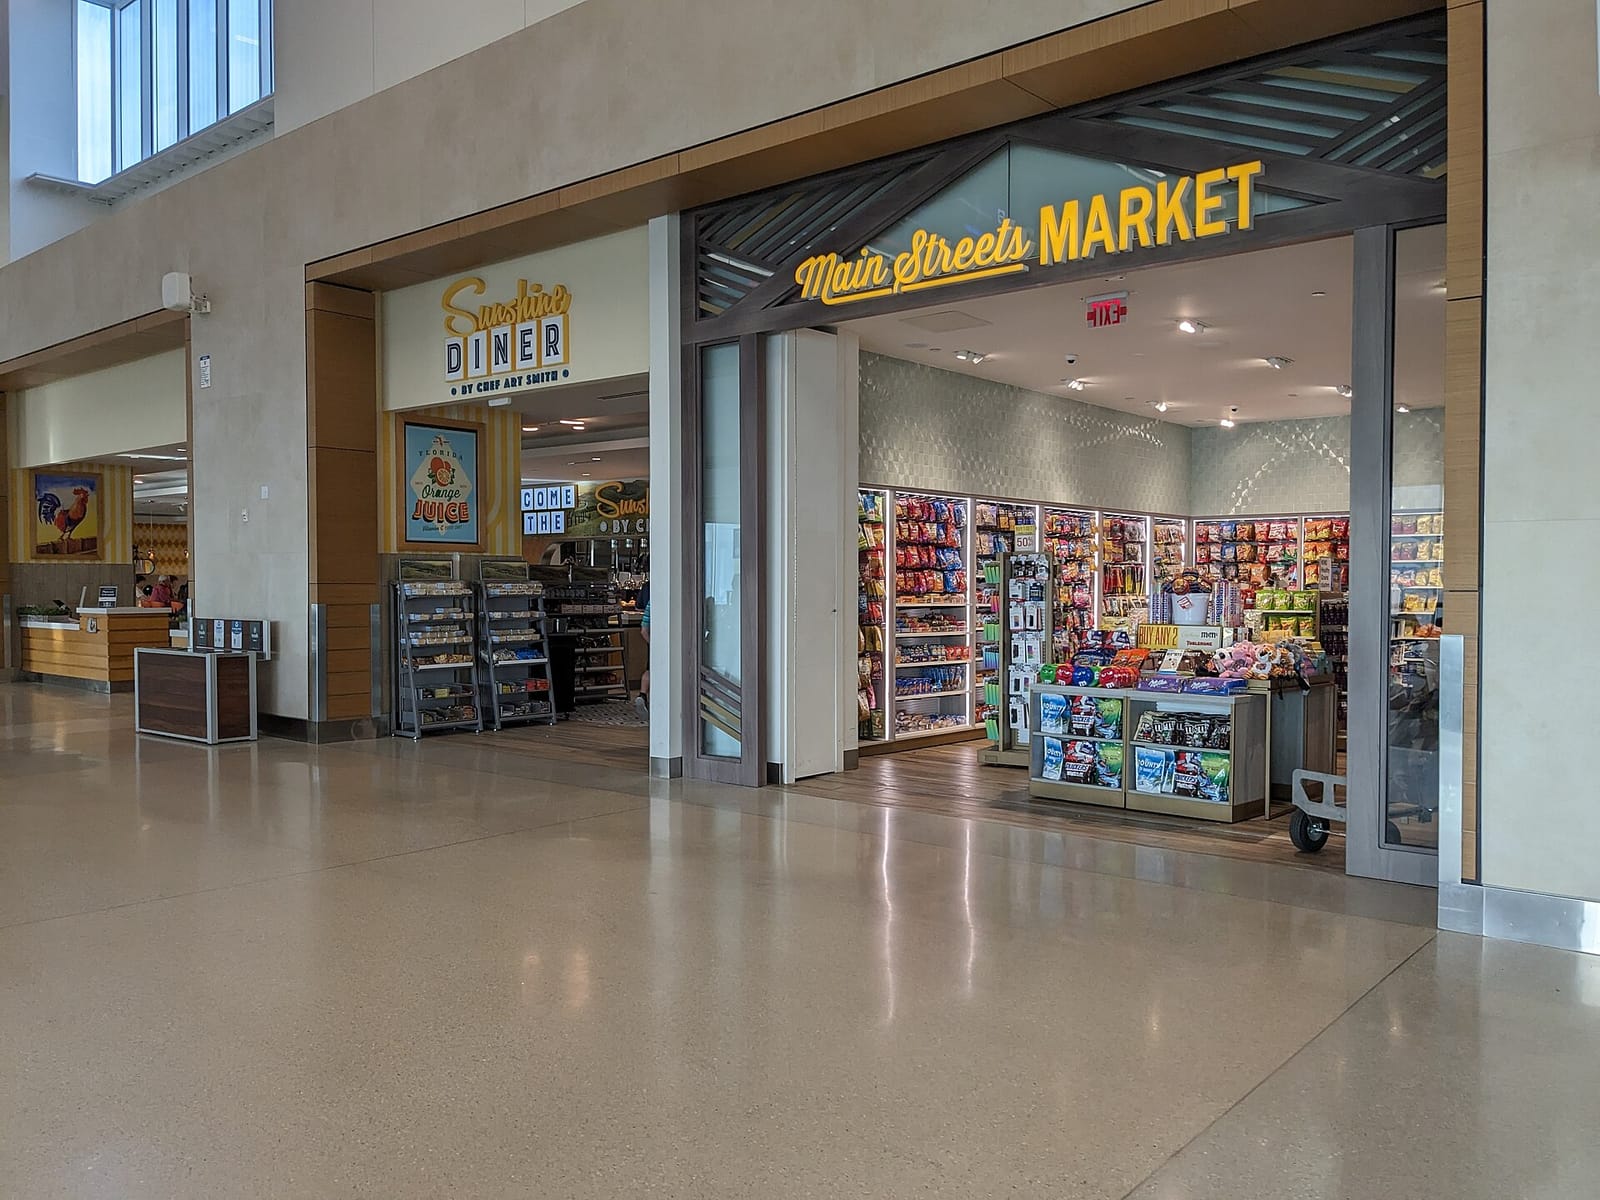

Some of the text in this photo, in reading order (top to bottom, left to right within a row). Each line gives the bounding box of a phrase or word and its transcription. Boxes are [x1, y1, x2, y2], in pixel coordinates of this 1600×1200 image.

[795, 160, 1265, 303] Main Streets MARKET
[442, 276, 572, 337] Sunshine
[447, 323, 560, 374] DINER
[461, 370, 558, 395] BY CHEF ART SMITH
[421, 484, 461, 502] Orange
[523, 488, 572, 507] COME
[412, 499, 470, 523] JUICE
[527, 514, 561, 531] THE
[612, 519, 630, 534] BY
[1138, 626, 1178, 646] BUY ANY 2
